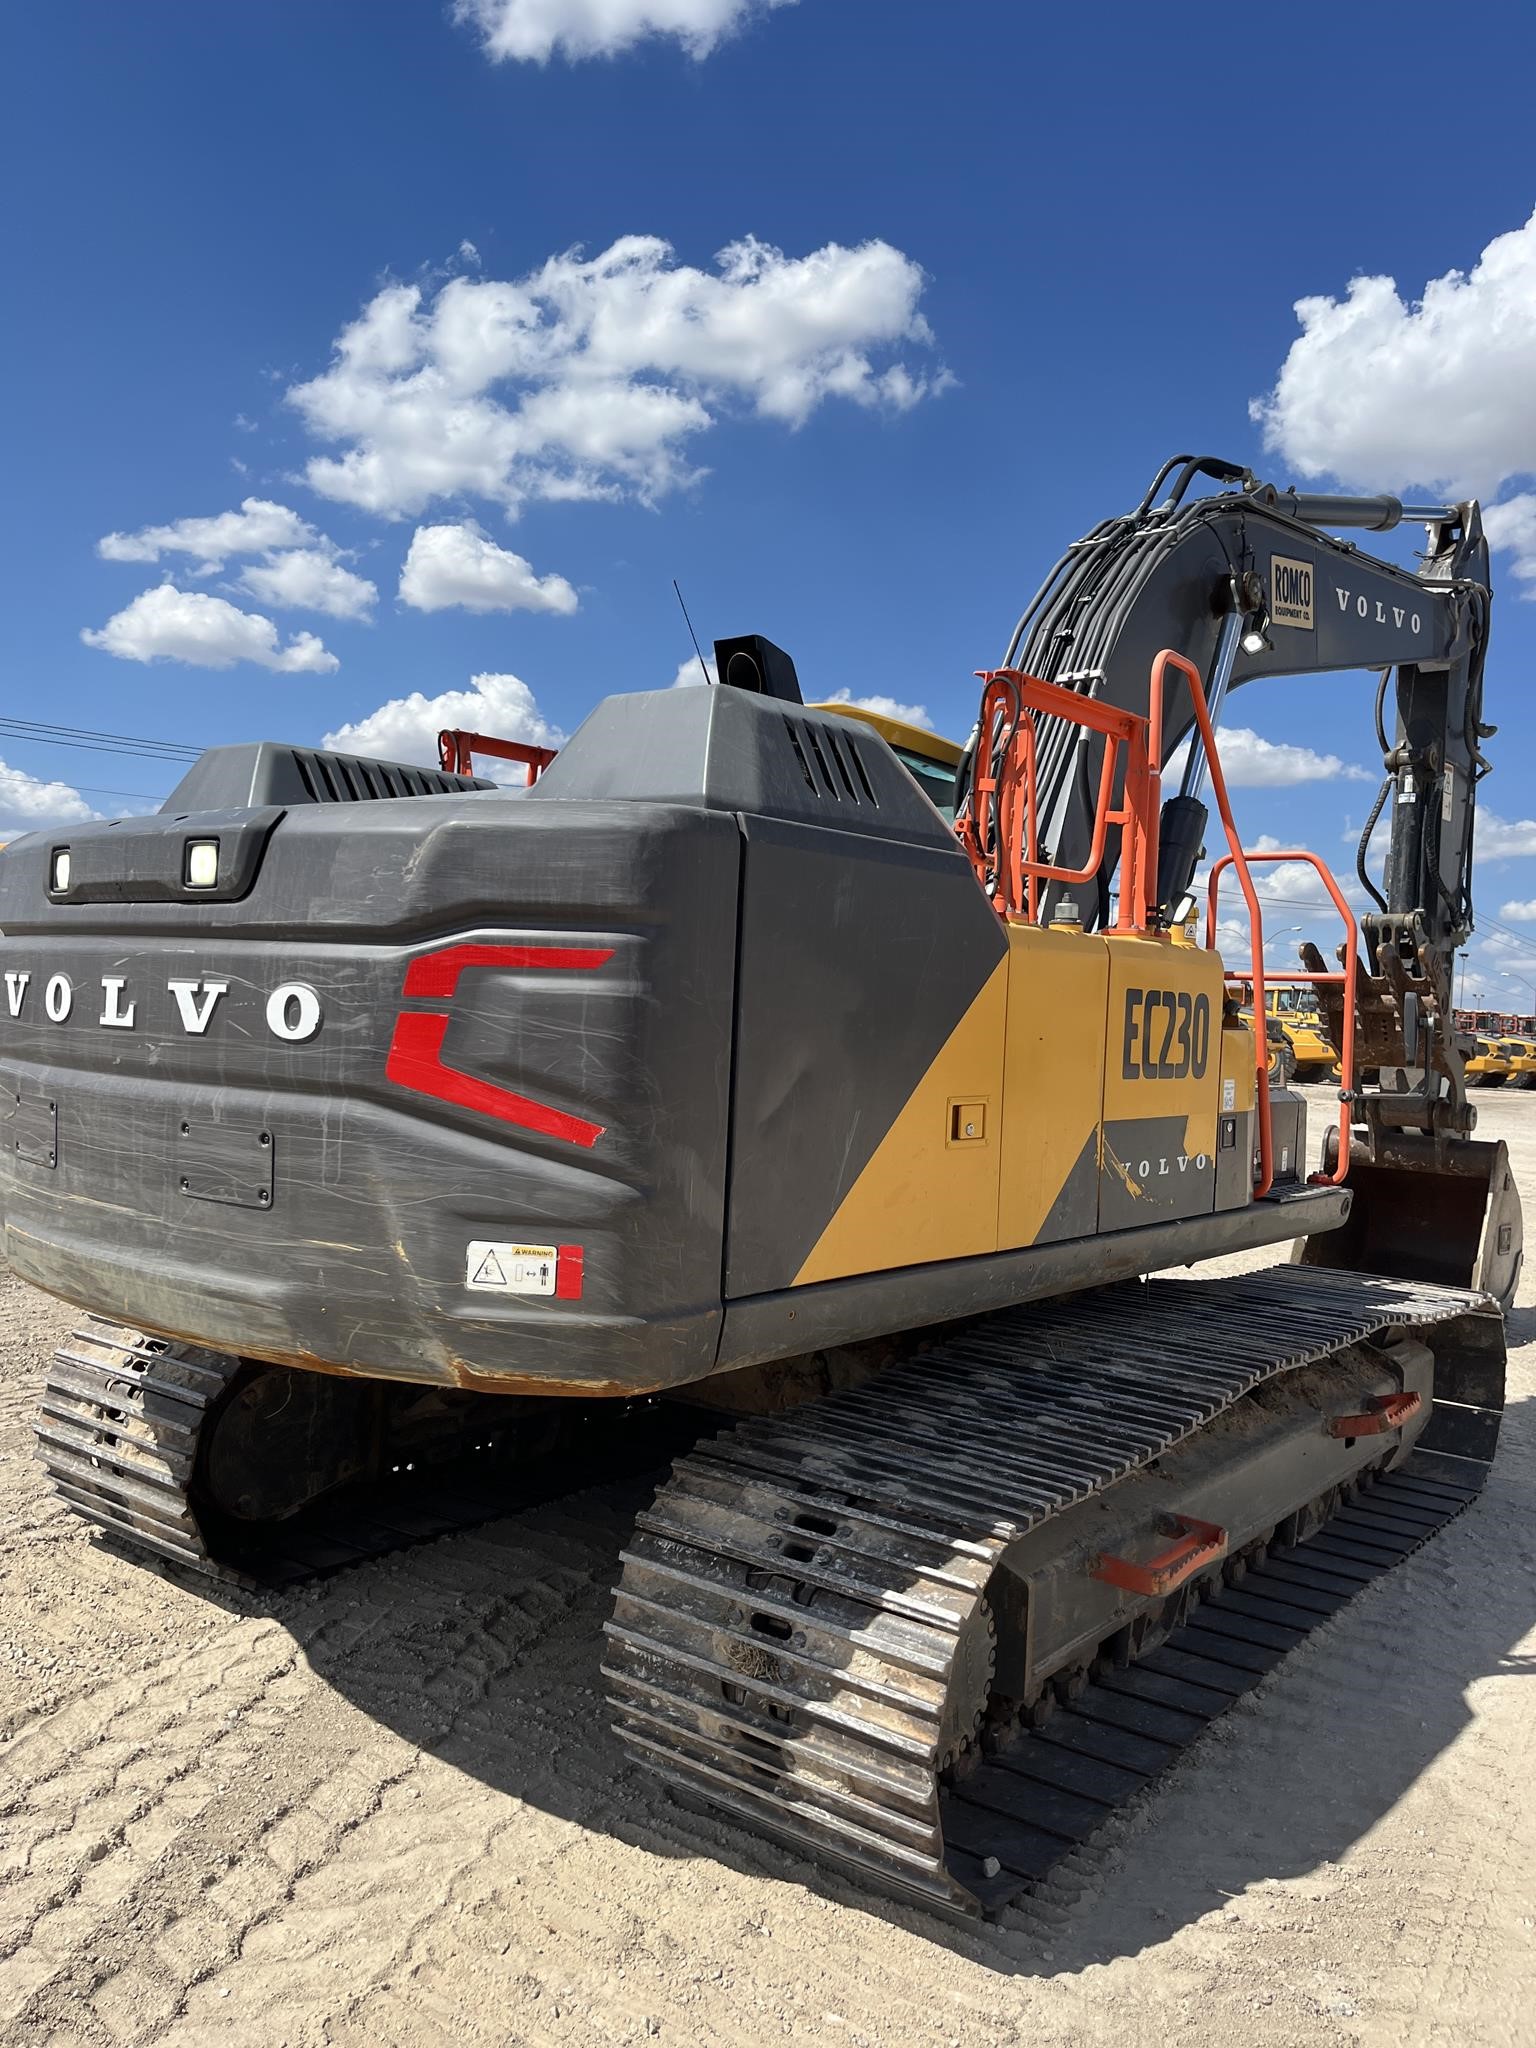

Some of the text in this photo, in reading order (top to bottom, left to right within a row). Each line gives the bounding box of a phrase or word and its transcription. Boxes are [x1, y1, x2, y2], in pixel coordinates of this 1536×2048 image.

[1275, 564, 1311, 608] ROMCO
[1275, 605, 1302, 619] EQUIPMENT
[1336, 587, 1421, 634] VOLVO
[4, 971, 322, 1041] VOLVO
[1122, 988, 1210, 1080] EC230
[521, 1250, 554, 1258] WARNING
